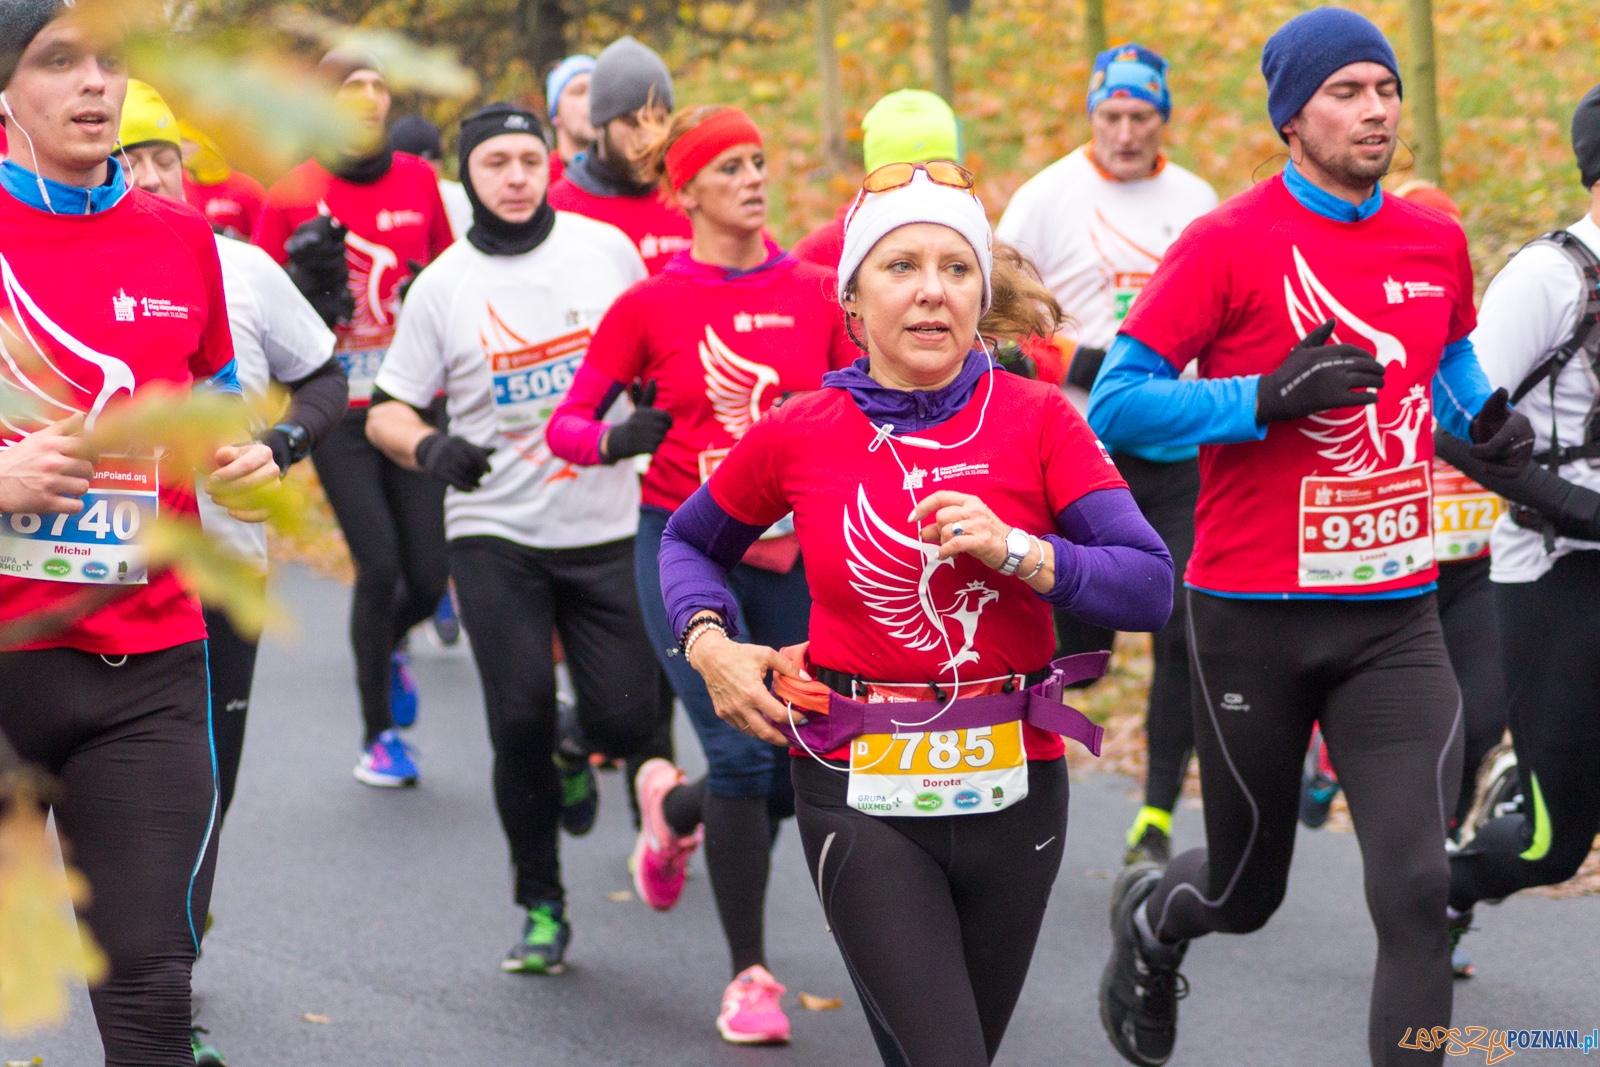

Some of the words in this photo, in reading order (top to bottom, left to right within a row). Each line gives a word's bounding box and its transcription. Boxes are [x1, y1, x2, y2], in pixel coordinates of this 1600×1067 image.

[140, 297, 151, 316] 1
[93, 471, 147, 483] unPoland.org
[931, 466, 942, 481] 1
[1305, 526, 1317, 539] B
[1322, 503, 1419, 550] 9366
[54, 545, 91, 556] Michal
[857, 741, 869, 755] D
[892, 726, 995, 770] 785
[923, 778, 962, 787] Dorota
[858, 794, 886, 802] GRUPA
[857, 802, 892, 811] LUXMED
